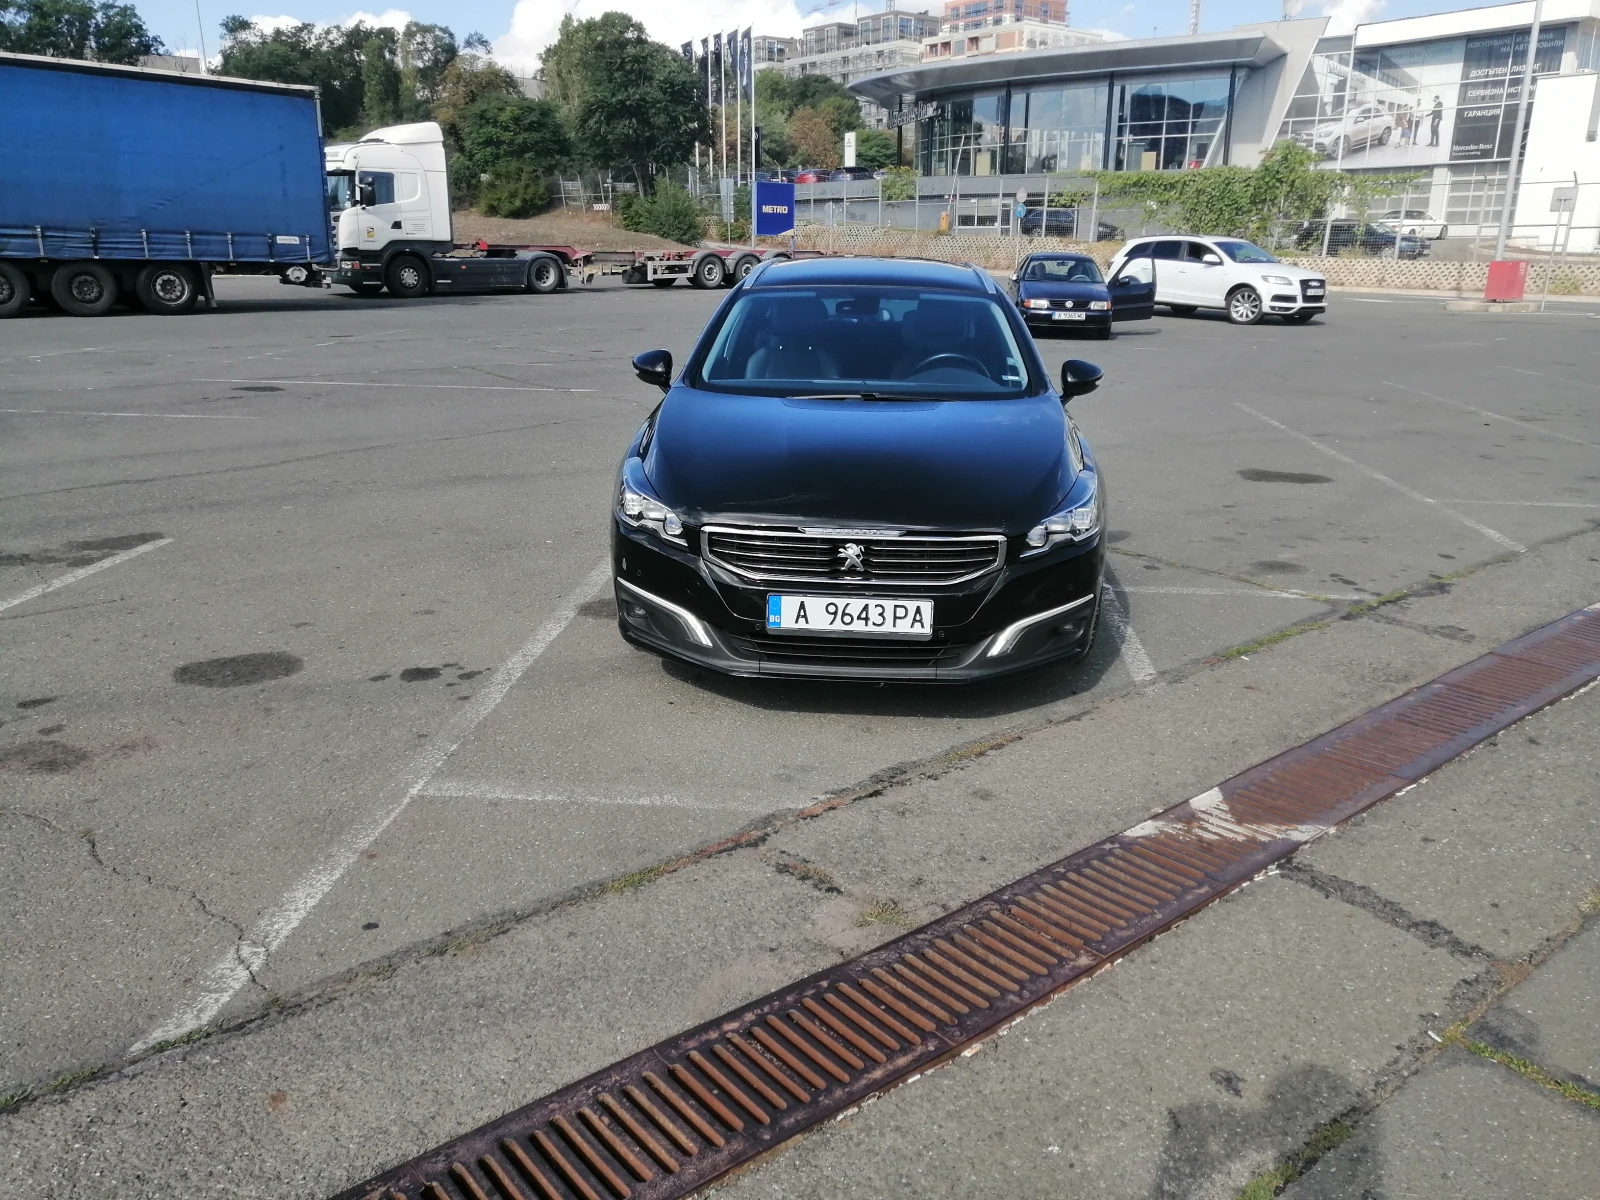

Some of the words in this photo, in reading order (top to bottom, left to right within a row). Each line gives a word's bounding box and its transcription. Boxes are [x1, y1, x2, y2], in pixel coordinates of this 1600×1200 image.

[1468, 38, 1512, 49] ИЗКУПУВАНЕ
[1524, 32, 1553, 42] ЗАЯНА
[1470, 67, 1507, 78] ДОСТЪПЕН
[1511, 63, 1541, 73] ЛИЗНГ
[1468, 87, 1504, 97] СЕРВИЗНА
[1464, 108, 1501, 118] ГАРАНЦИЯ
[762, 205, 788, 214] METRO
[795, 600, 809, 624] A
